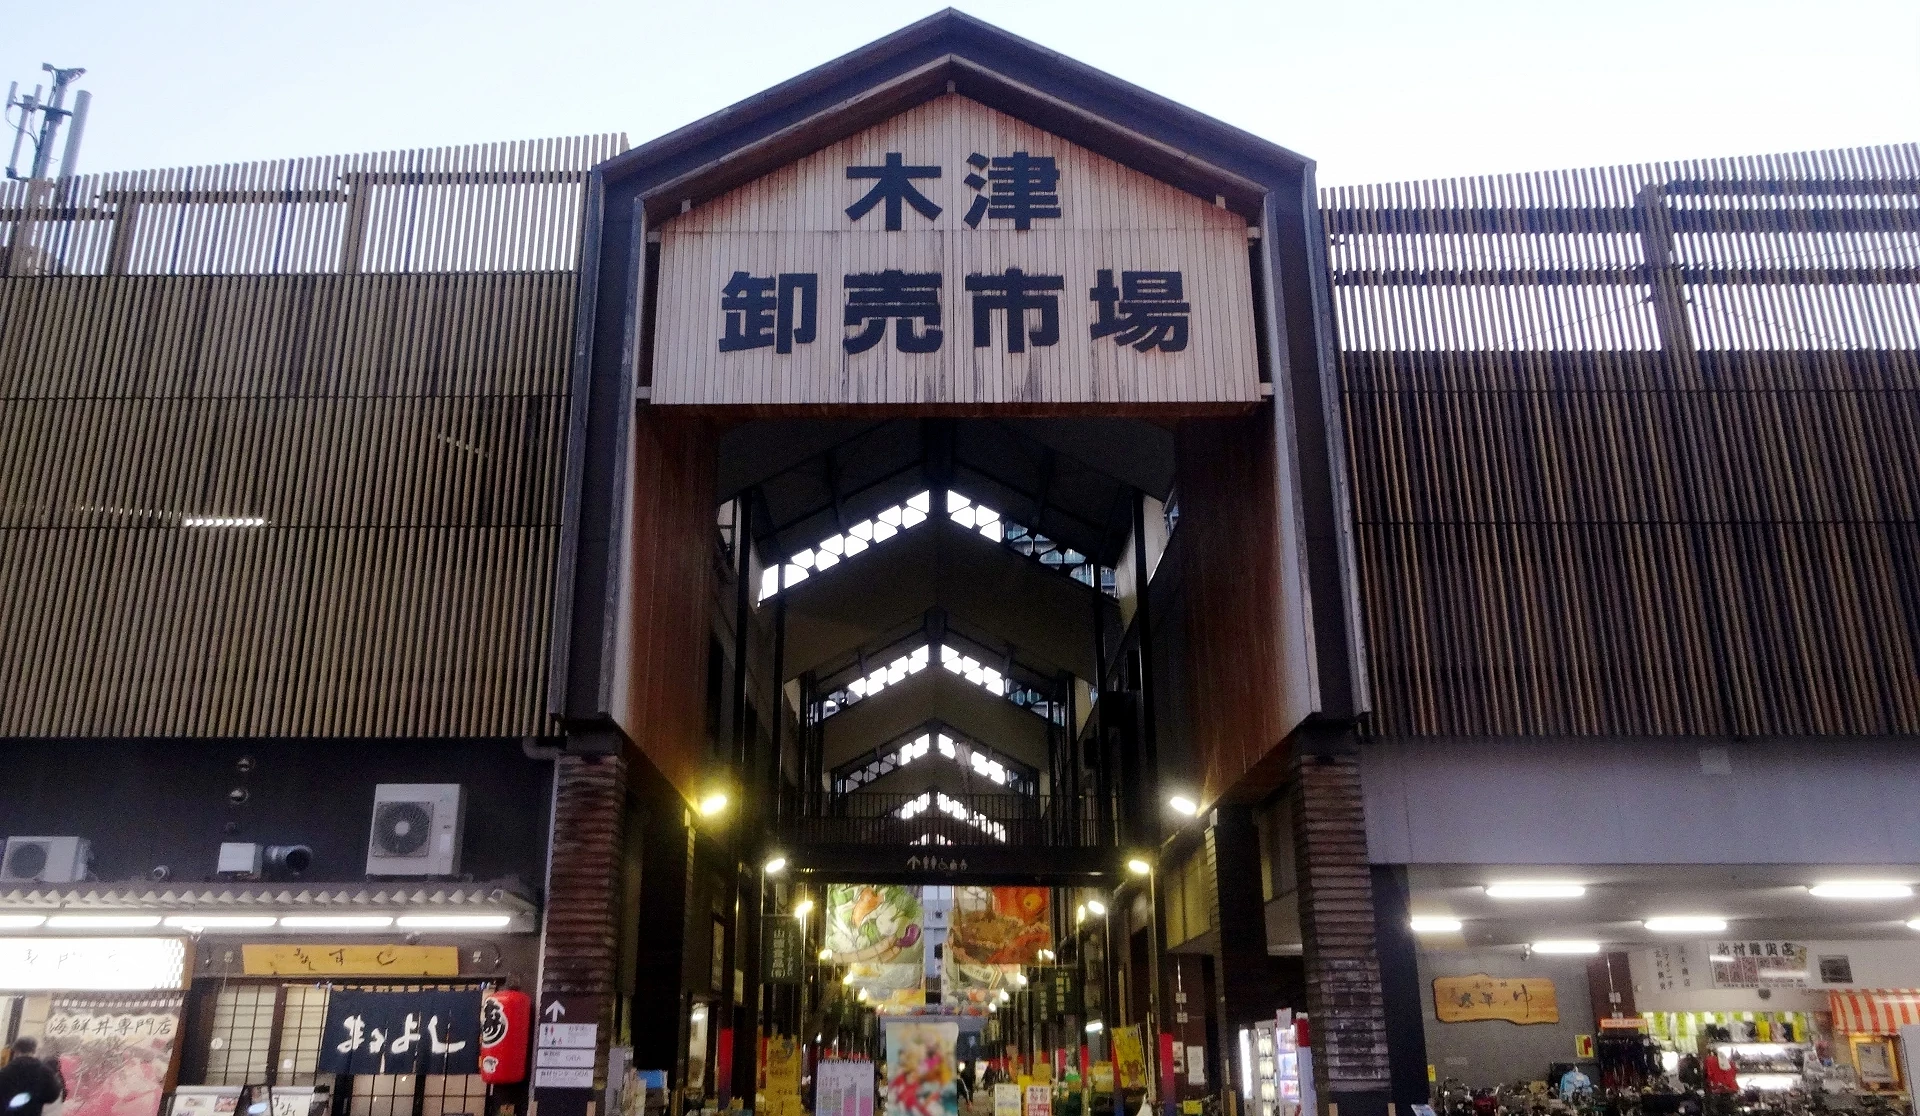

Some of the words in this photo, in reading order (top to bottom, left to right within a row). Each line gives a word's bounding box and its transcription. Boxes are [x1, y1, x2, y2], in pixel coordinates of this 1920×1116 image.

[846, 151, 1061, 231] 木津
[718, 267, 1191, 354] 卸売市場
